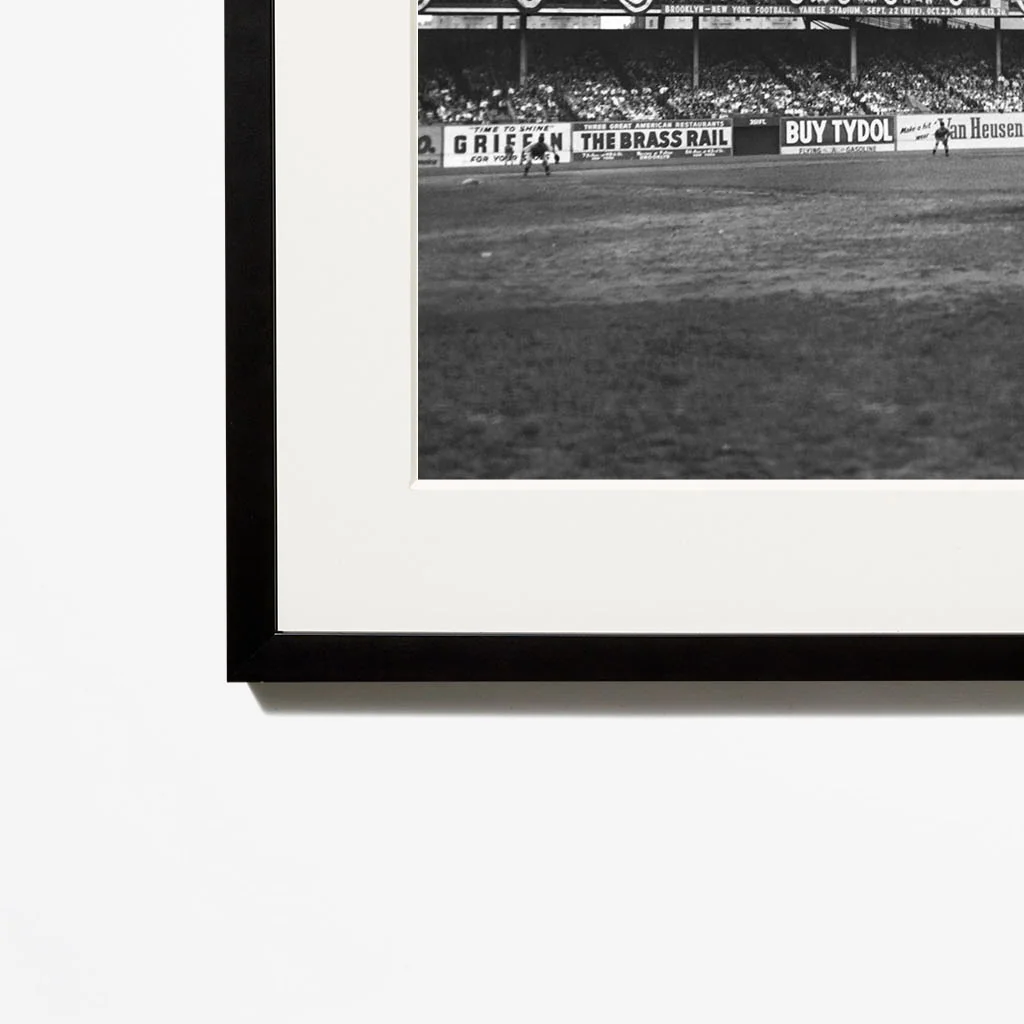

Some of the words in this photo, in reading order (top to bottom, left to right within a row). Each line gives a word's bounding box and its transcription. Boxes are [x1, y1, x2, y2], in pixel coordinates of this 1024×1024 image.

[732, 5, 750, 14] YORK
[800, 6, 826, 14] YANKEE
[786, 120, 827, 144] BUY
[832, 118, 893, 143] TYDOL
[970, 117, 1024, 139] Heusen
[454, 132, 563, 154] GRIFFN
[581, 132, 616, 150] THE
[620, 130, 682, 149] BRASS
[686, 129, 728, 147] RAIL
